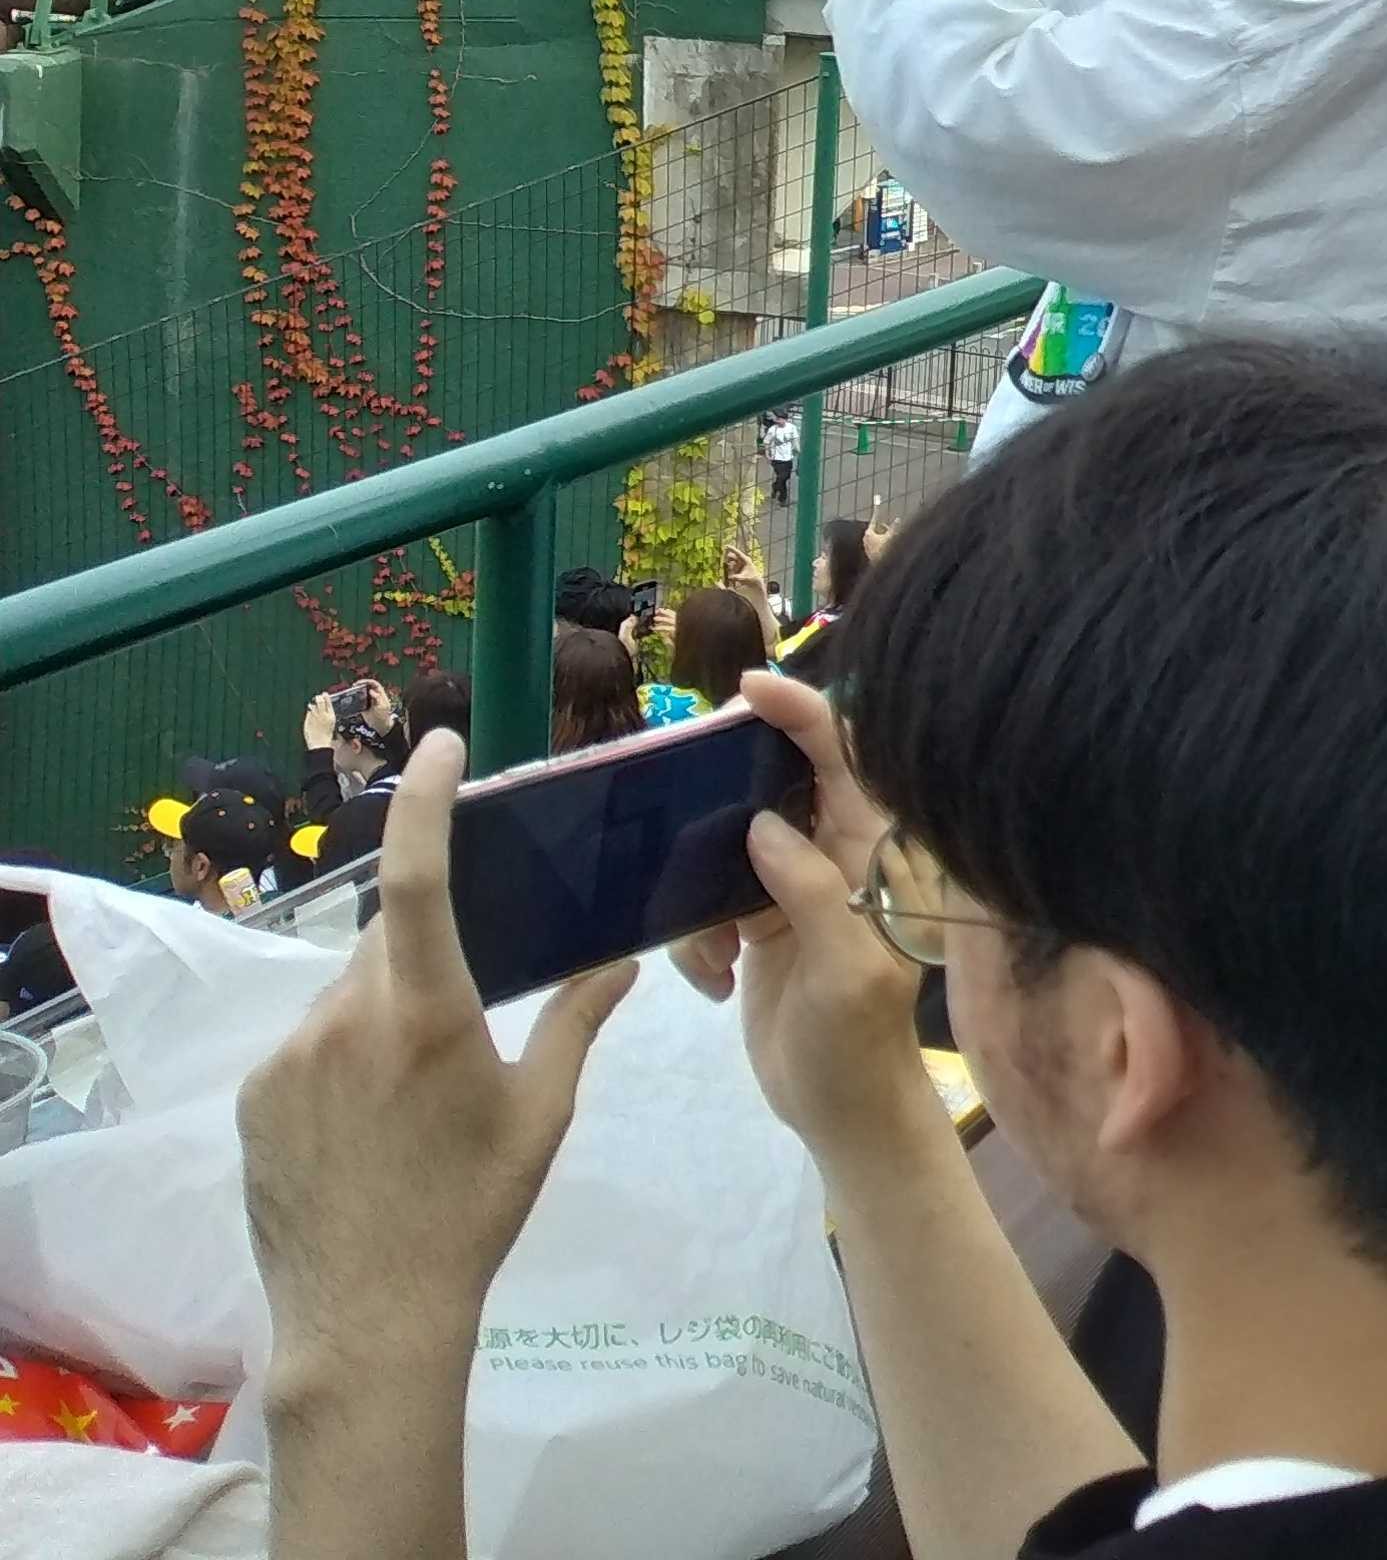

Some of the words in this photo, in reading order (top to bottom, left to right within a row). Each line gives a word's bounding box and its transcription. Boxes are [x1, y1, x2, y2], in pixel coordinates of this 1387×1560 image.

[489, 1356, 572, 1372] Please
[580, 1358, 648, 1371] reuse
[655, 1353, 699, 1371] this
[704, 1351, 748, 1377] bag
[751, 1352, 766, 1377] to
[770, 1363, 800, 1391] save
